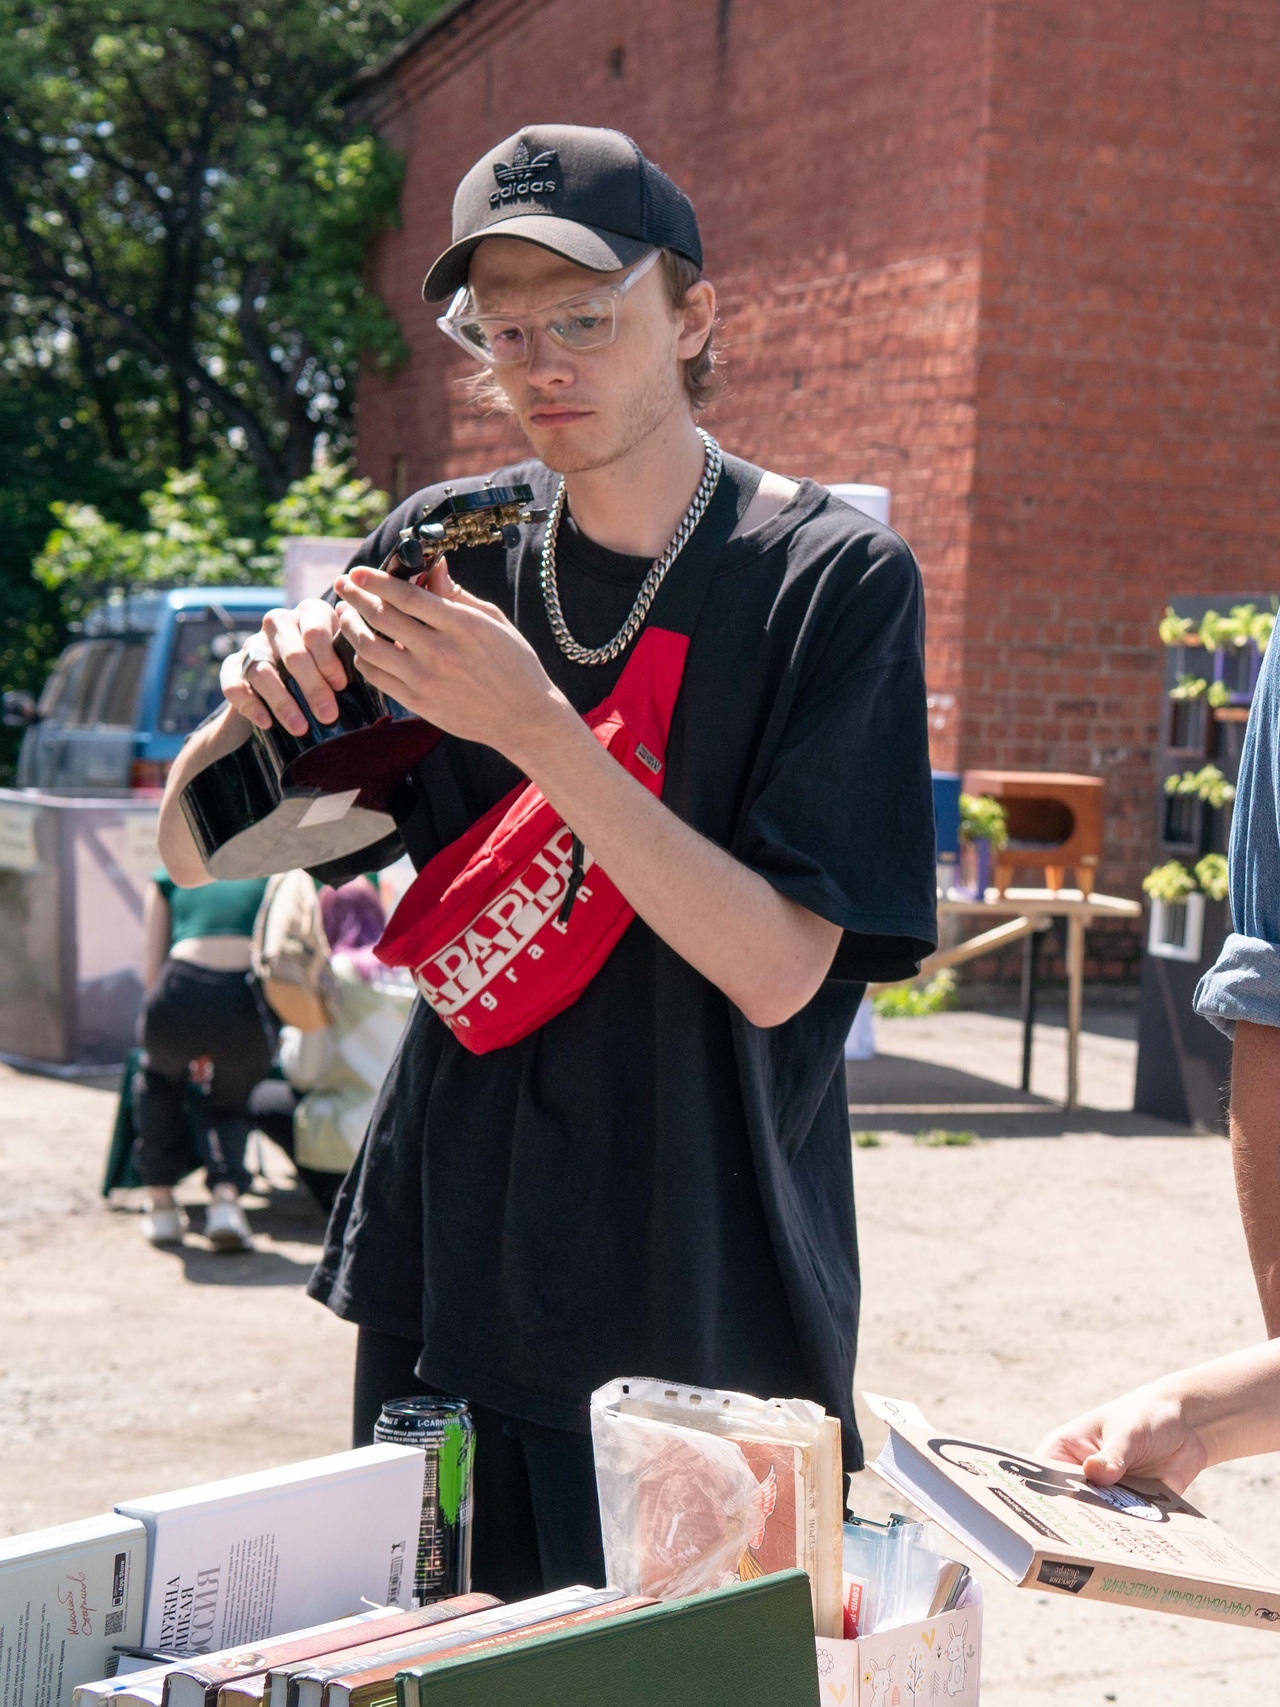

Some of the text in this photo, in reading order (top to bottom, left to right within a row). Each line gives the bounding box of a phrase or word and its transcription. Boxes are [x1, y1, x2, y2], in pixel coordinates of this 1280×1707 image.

[489, 180, 556, 202] adidas
[1048, 1576, 1078, 1589] Джулия
[1054, 1566, 1080, 1579] Эндерс
[160, 1574, 180, 1648] НУЖНА
[1099, 1577, 1252, 1617] ОЧАРОВАТЕЛЬНЫЙ КИШЕЧНИК
[175, 1584, 194, 1652] ЛИКАЯ
